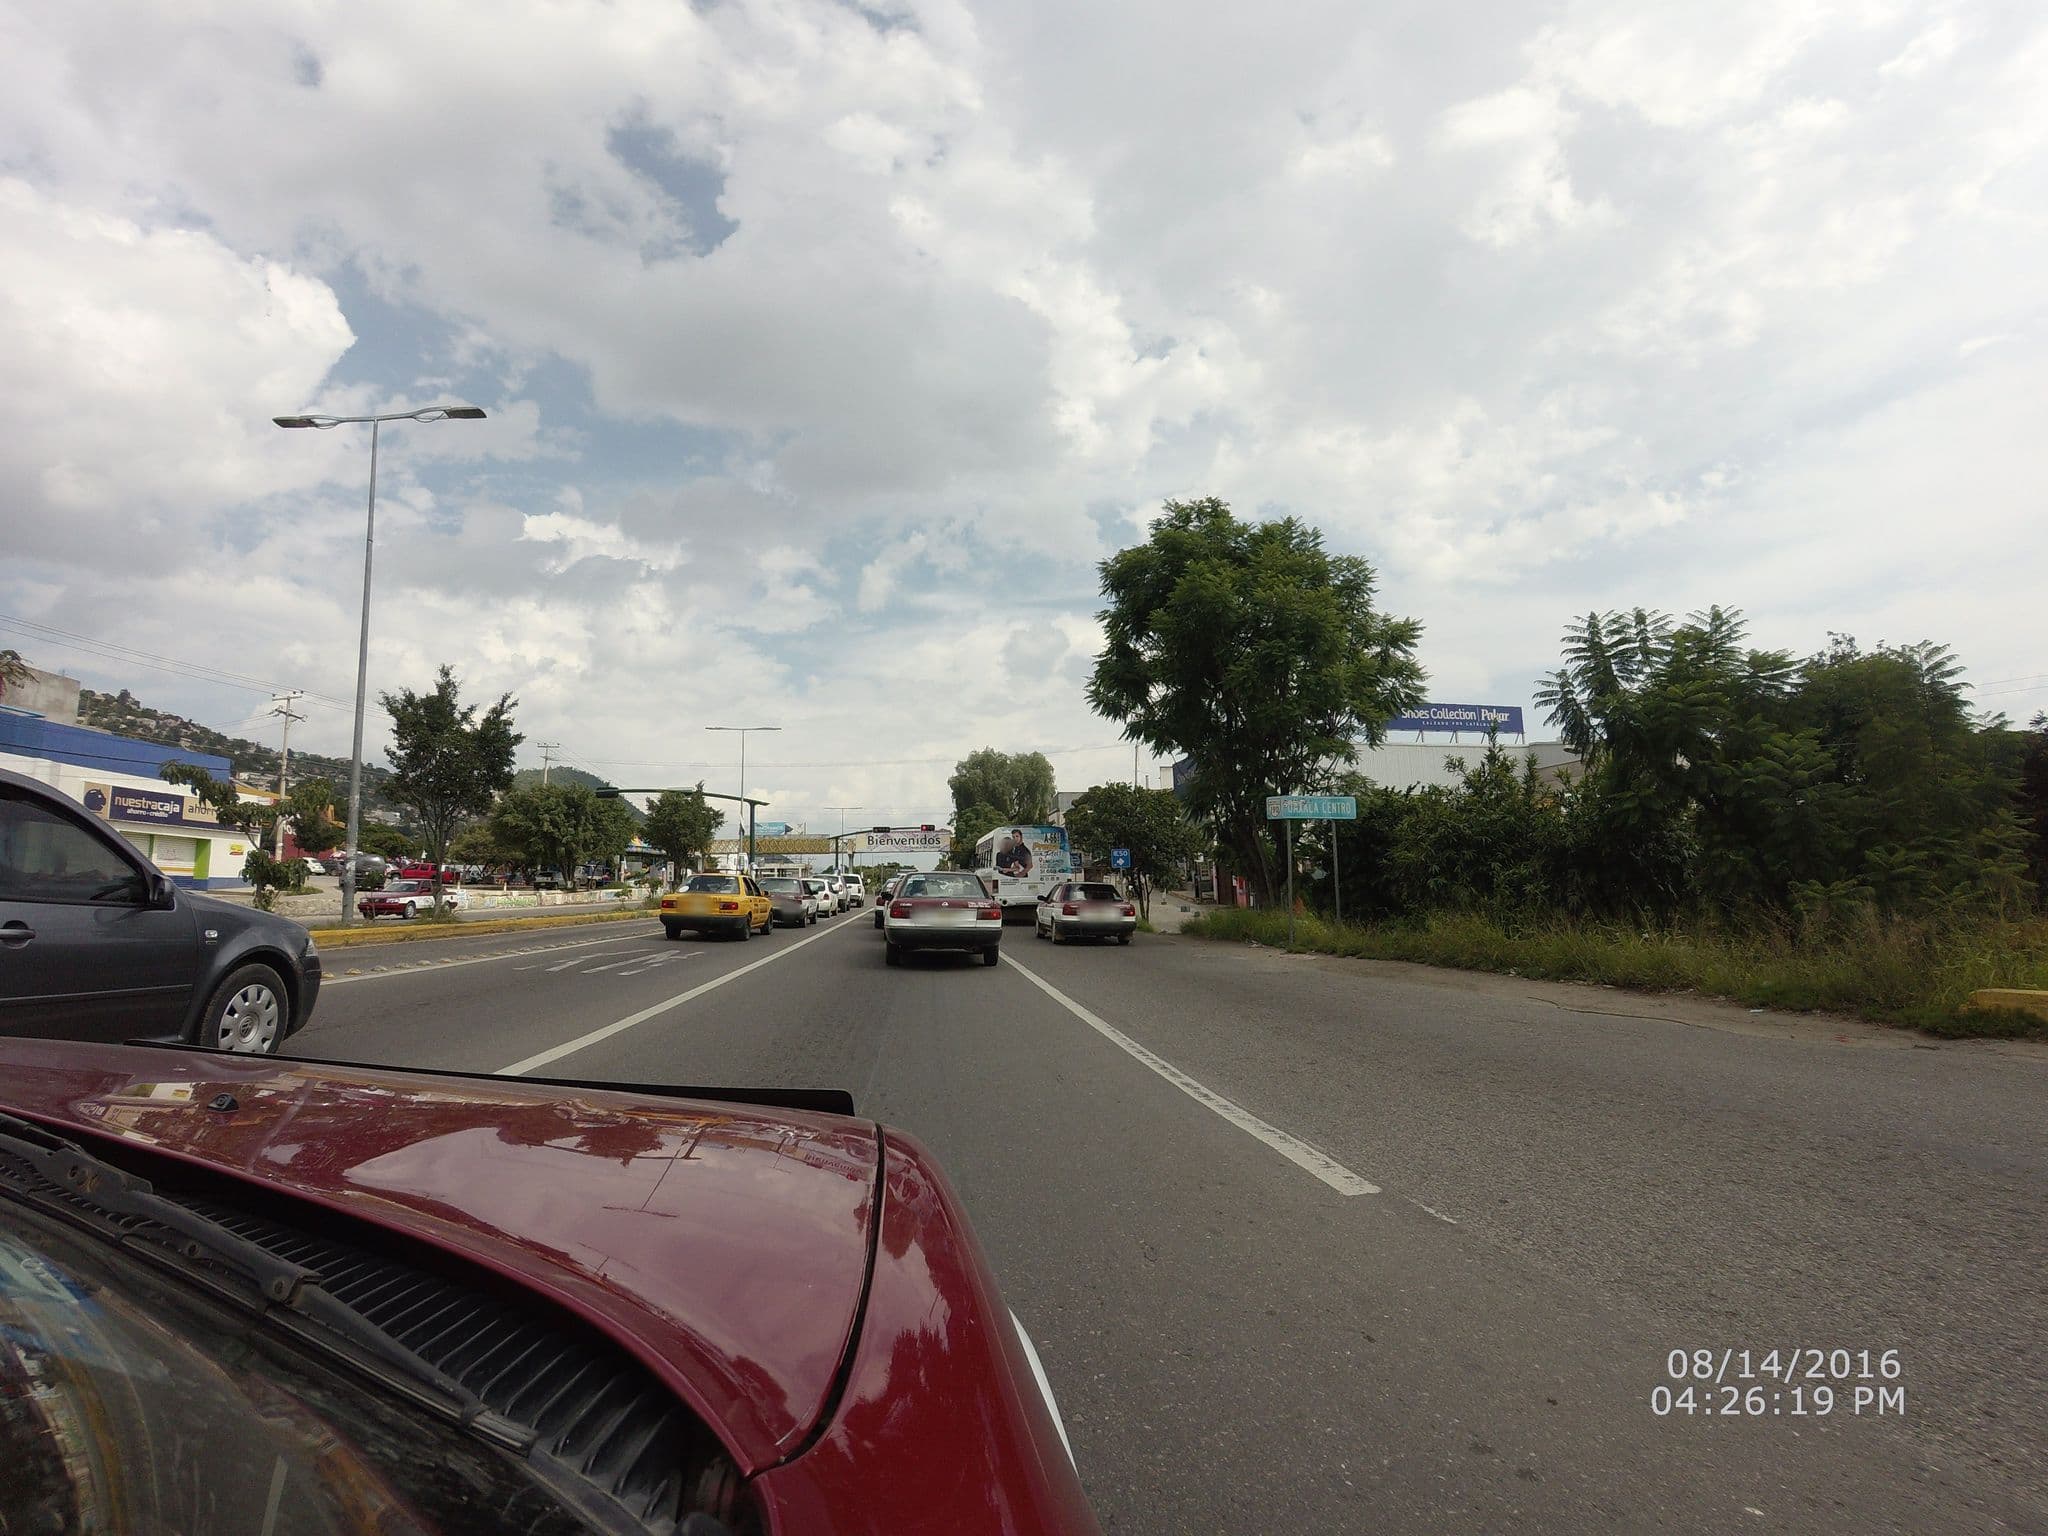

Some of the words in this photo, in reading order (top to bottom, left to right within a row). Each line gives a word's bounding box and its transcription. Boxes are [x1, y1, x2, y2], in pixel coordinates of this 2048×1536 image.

[1430, 708, 1477, 720] Collection
[114, 796, 180, 814] nuestracaja
[1322, 802, 1351, 814] CENTRO
[867, 834, 941, 846] Bienvenidos
